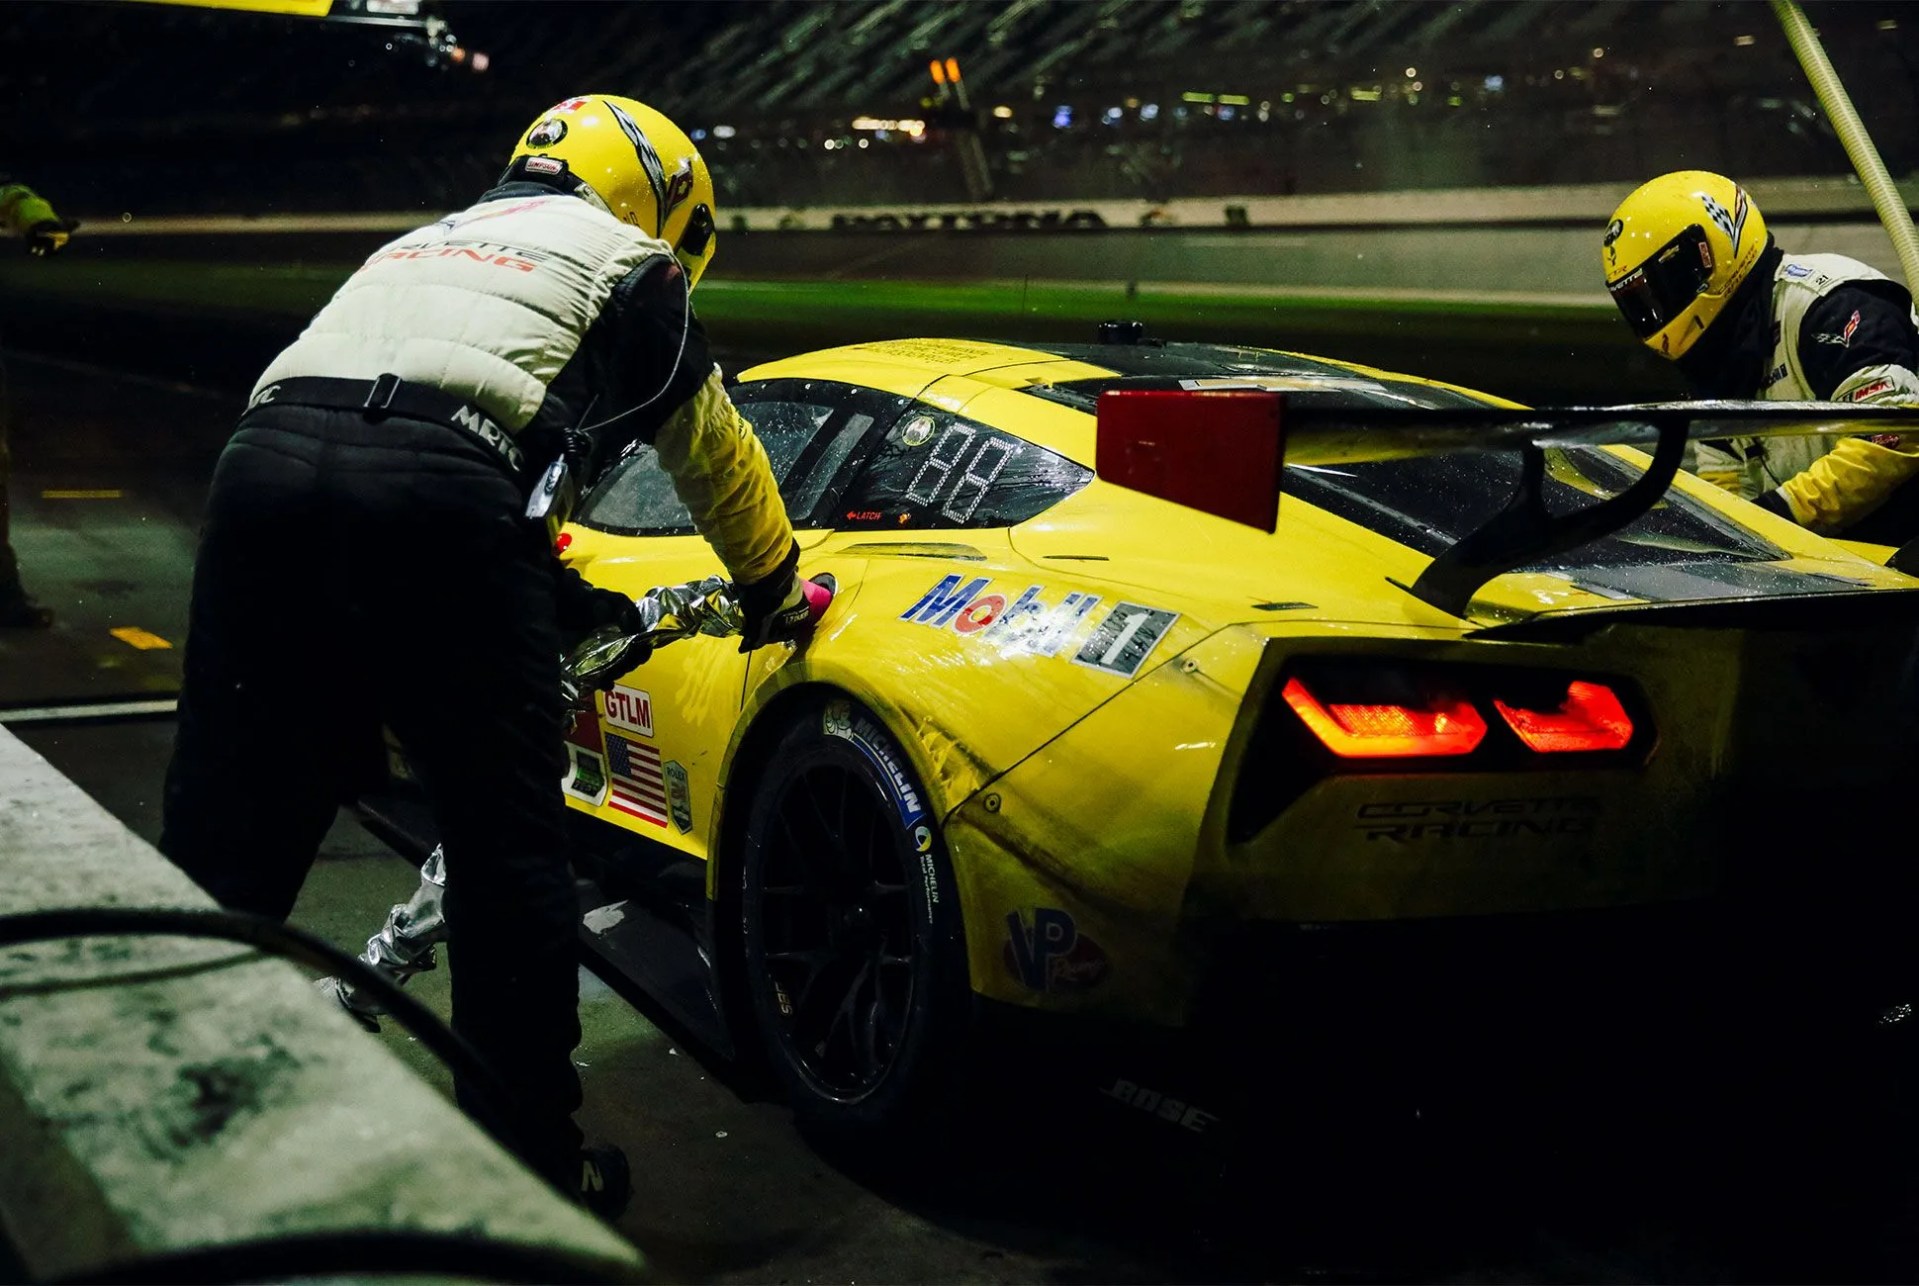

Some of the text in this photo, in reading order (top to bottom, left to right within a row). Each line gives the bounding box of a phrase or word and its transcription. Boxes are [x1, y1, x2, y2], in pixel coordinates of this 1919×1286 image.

[1815, 274, 1829, 285] 21
[856, 510, 883, 521] LATCH
[900, 573, 1104, 658] Mobil
[604, 690, 652, 730] GTLM
[854, 716, 922, 814] MICHELIN
[925, 853, 940, 904] MICHELIN
[1006, 907, 1077, 991] VP
[1097, 1077, 1222, 1134] BOSE
